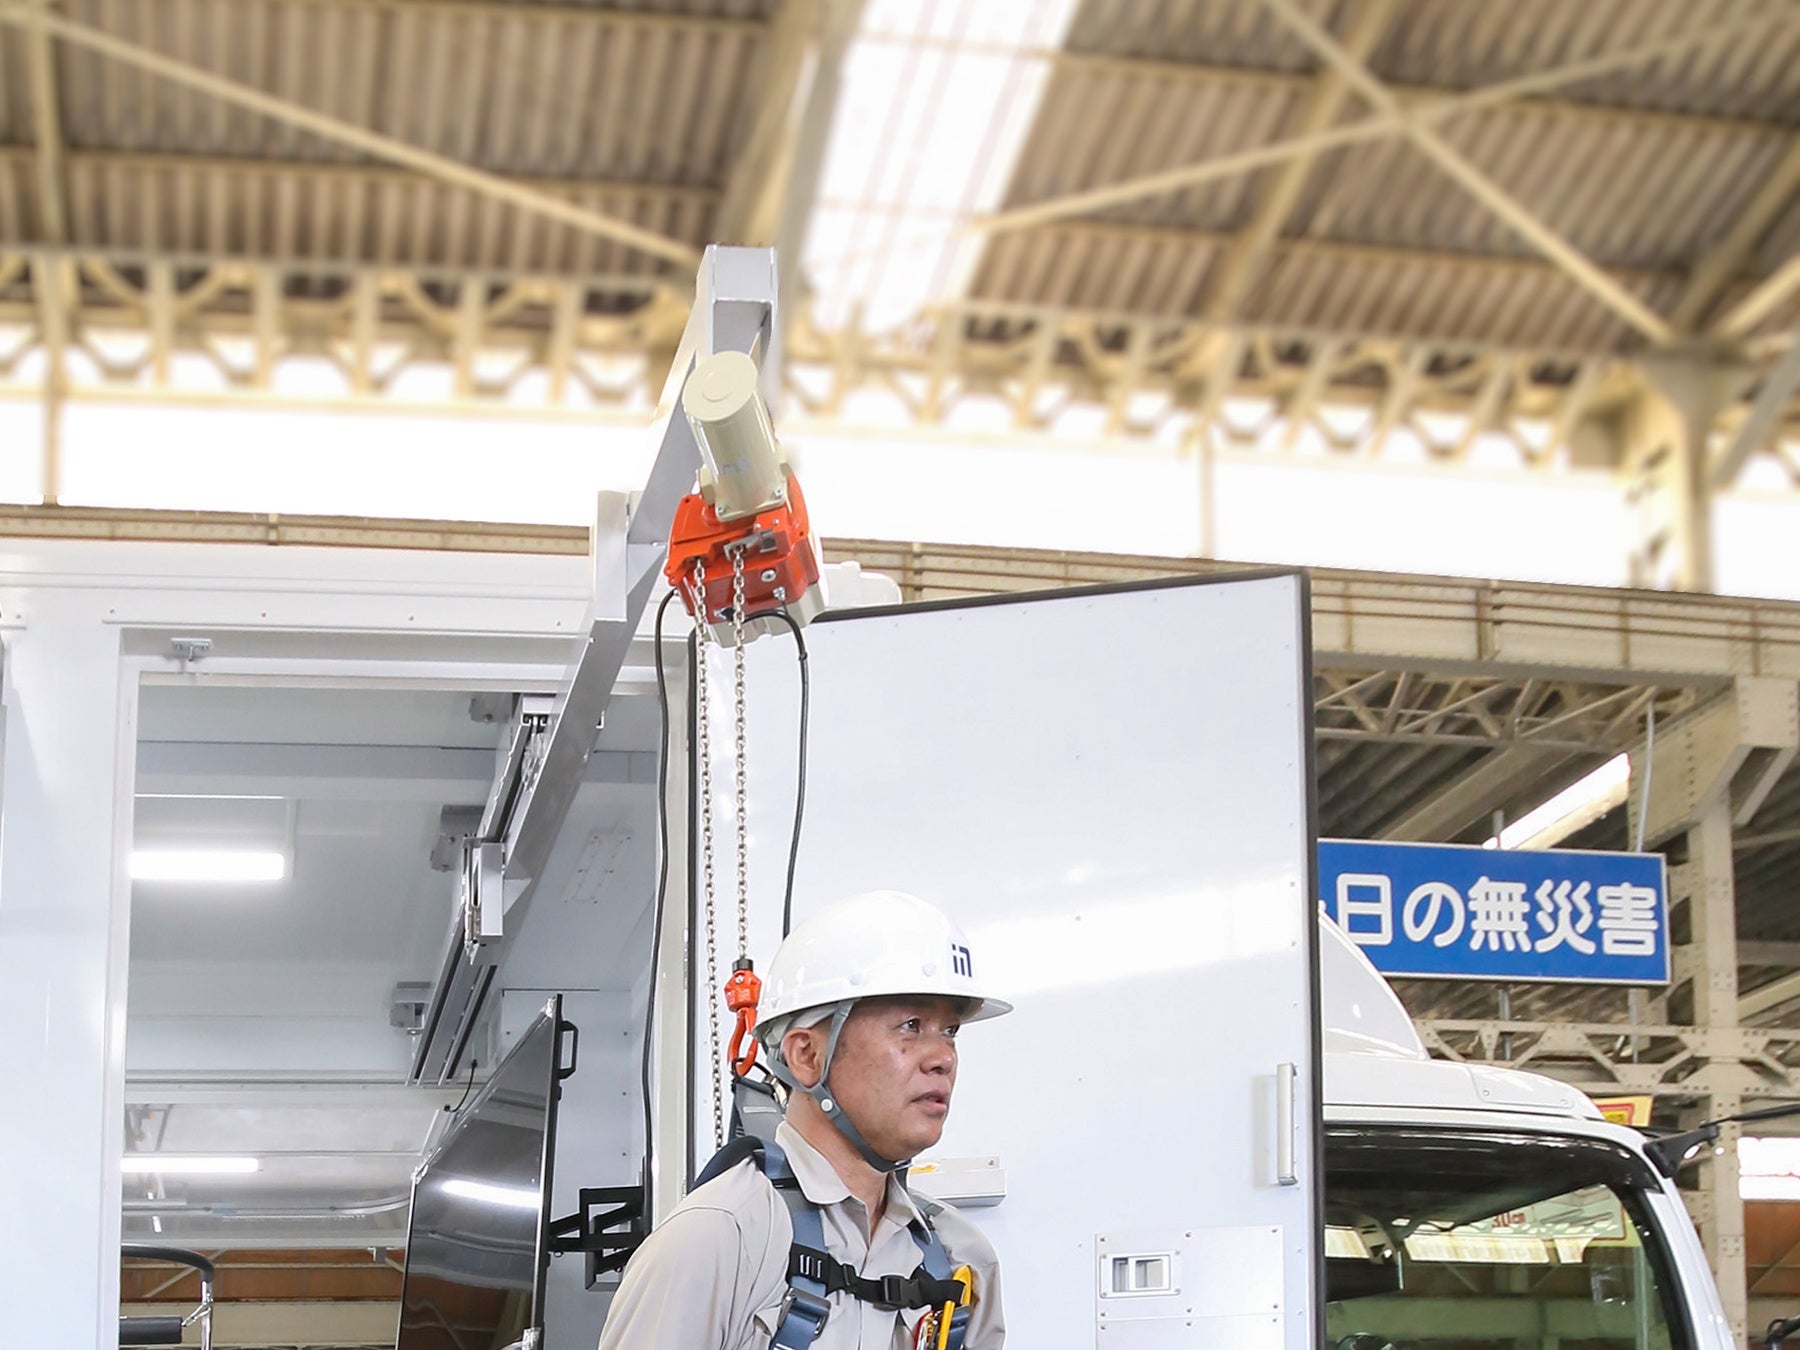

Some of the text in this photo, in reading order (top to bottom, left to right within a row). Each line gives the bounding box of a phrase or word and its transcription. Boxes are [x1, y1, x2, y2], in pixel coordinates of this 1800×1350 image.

[1318, 873, 1659, 956] 日の無災害
